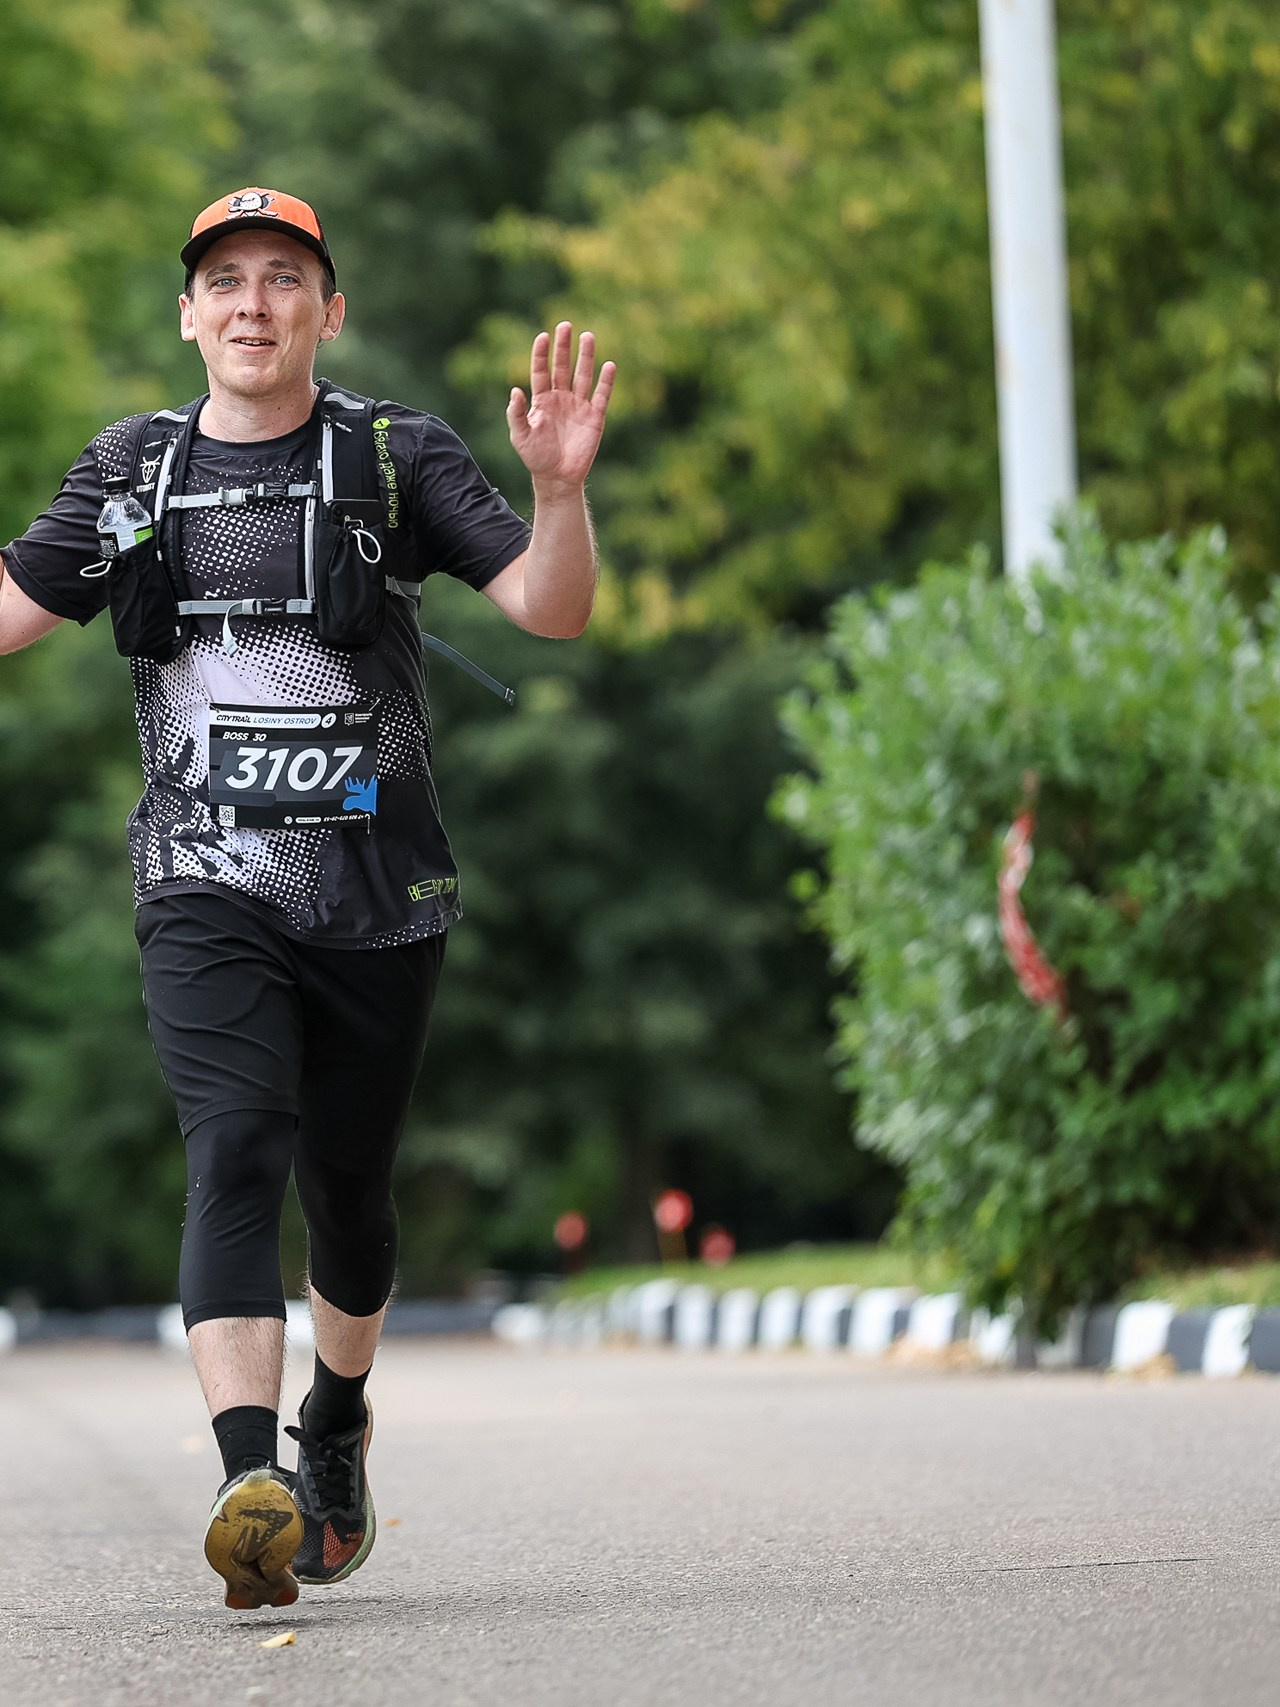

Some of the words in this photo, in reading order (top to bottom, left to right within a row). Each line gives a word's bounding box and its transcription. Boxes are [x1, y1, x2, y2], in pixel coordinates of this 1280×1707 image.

[378, 462, 398, 490] даже
[387, 492, 399, 529] ночью
[284, 717, 317, 725] OSTROV
[325, 716, 333, 725] 4
[222, 731, 249, 741] BOSS
[253, 733, 267, 742] 30
[224, 746, 363, 792] 3107
